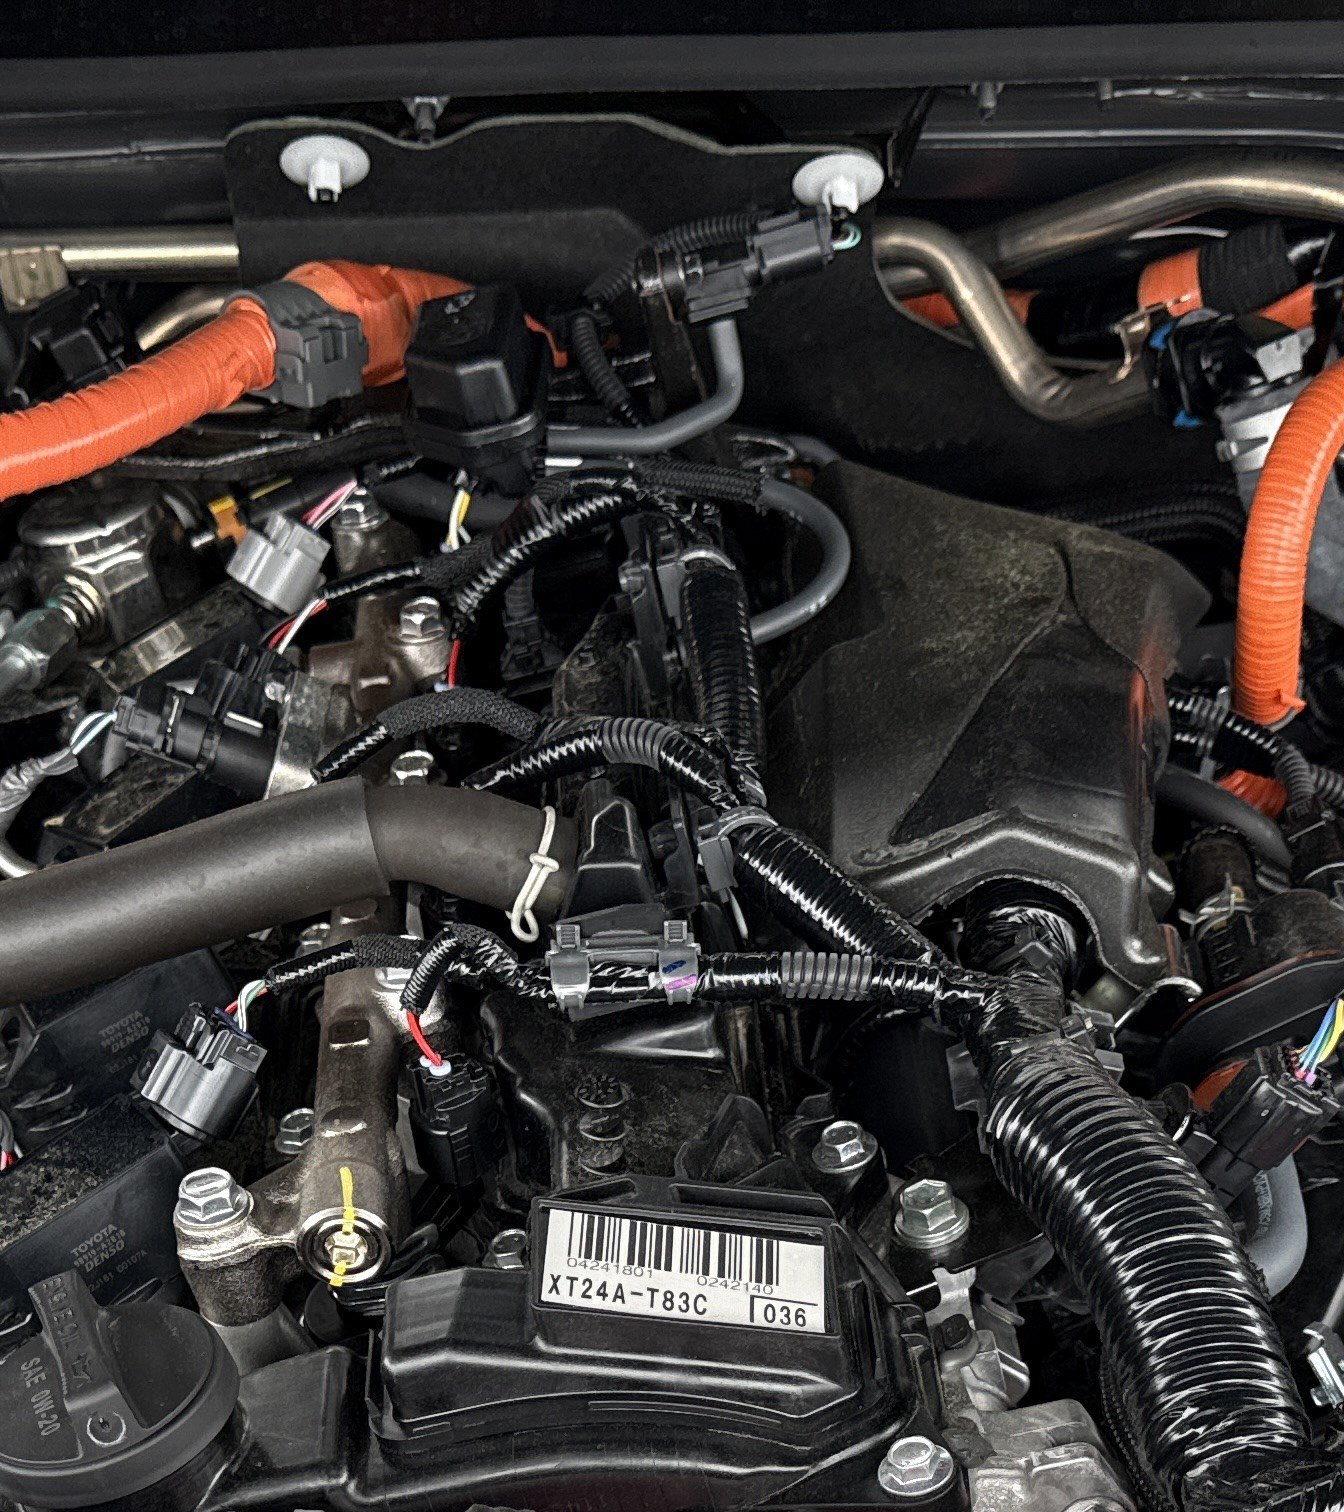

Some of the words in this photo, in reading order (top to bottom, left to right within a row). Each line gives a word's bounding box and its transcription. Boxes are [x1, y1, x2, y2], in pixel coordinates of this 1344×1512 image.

[98, 1010, 143, 1037] TOYOTA
[112, 1026, 149, 1053] DENSO
[70, 1224, 117, 1257] TOYOTA
[84, 1240, 124, 1272] DENSO
[567, 1258, 653, 1278] 04241801
[697, 1275, 774, 1295] 0242140
[548, 1273, 708, 1316] XT24A-T83C
[763, 1303, 807, 1327] 036
[20, 1357, 47, 1388] SAE
[31, 1389, 61, 1436] 0W-20
